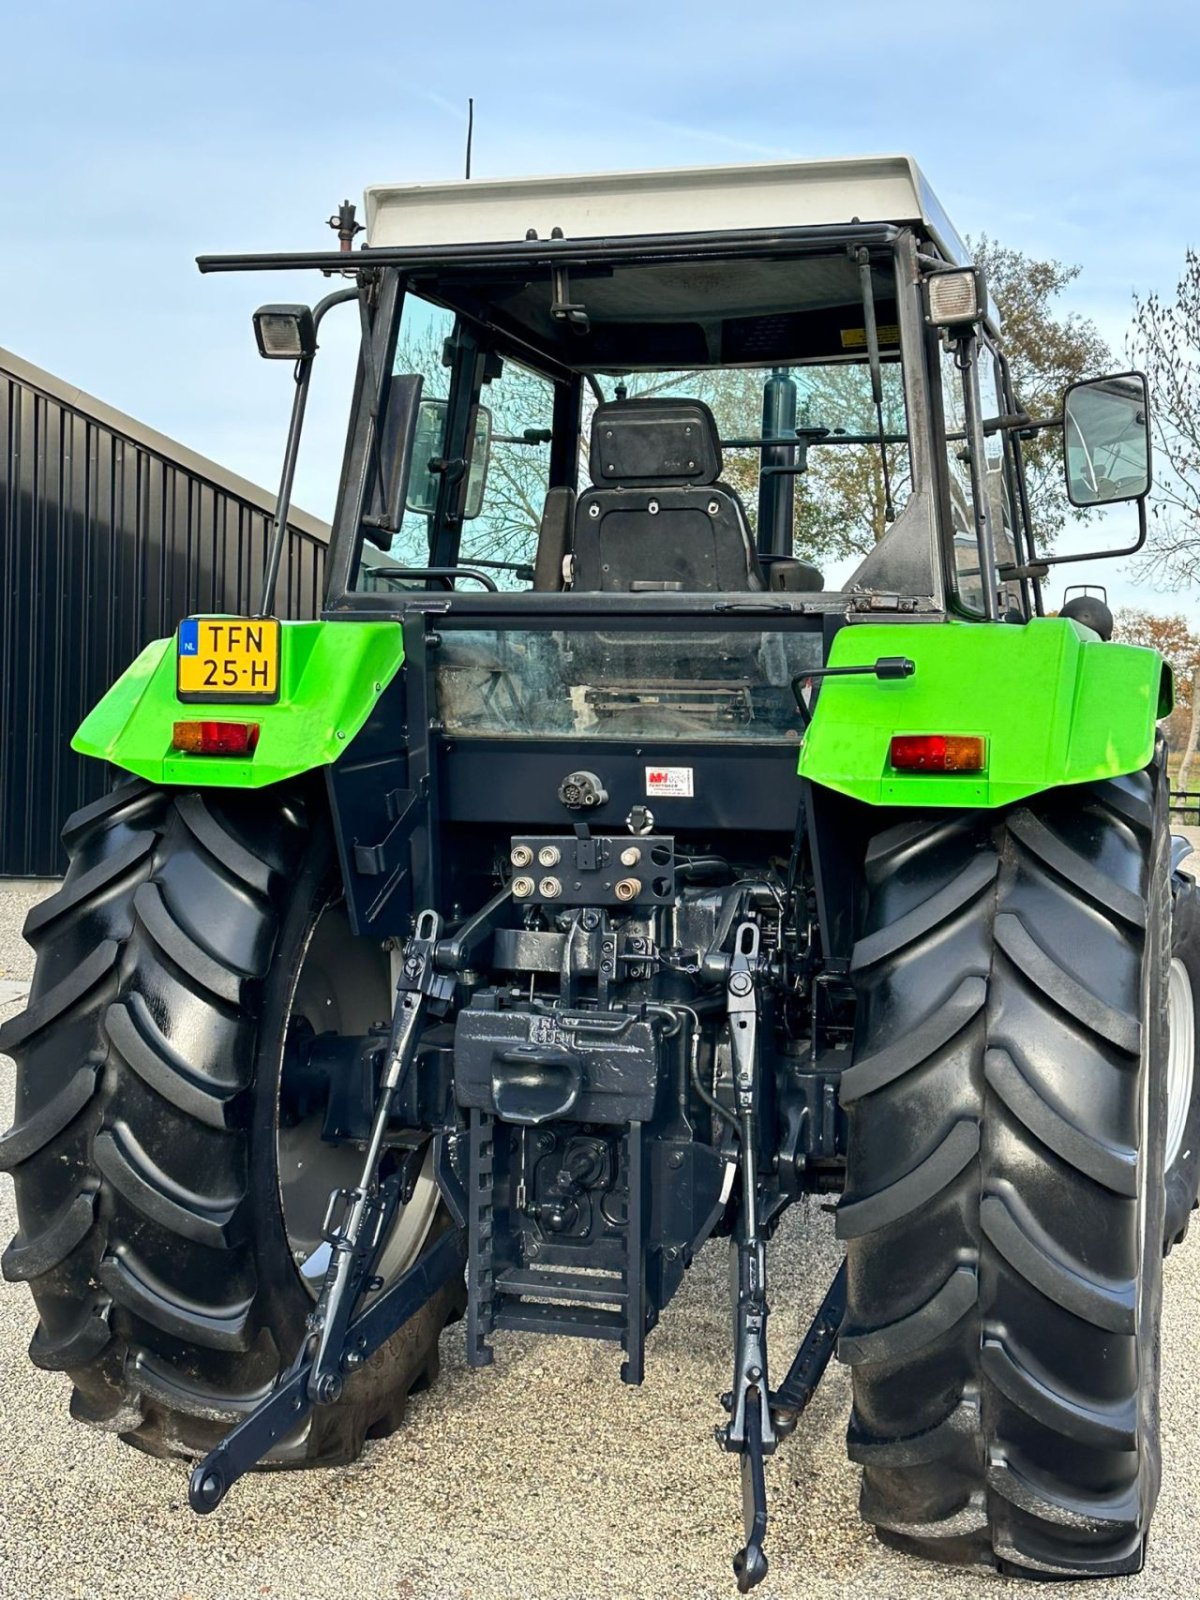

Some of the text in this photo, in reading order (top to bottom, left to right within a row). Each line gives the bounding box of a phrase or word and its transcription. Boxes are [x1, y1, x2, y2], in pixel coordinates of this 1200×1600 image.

[184, 642, 195, 651] NL
[208, 626, 263, 653] TFN
[203, 659, 268, 687] 25-H
